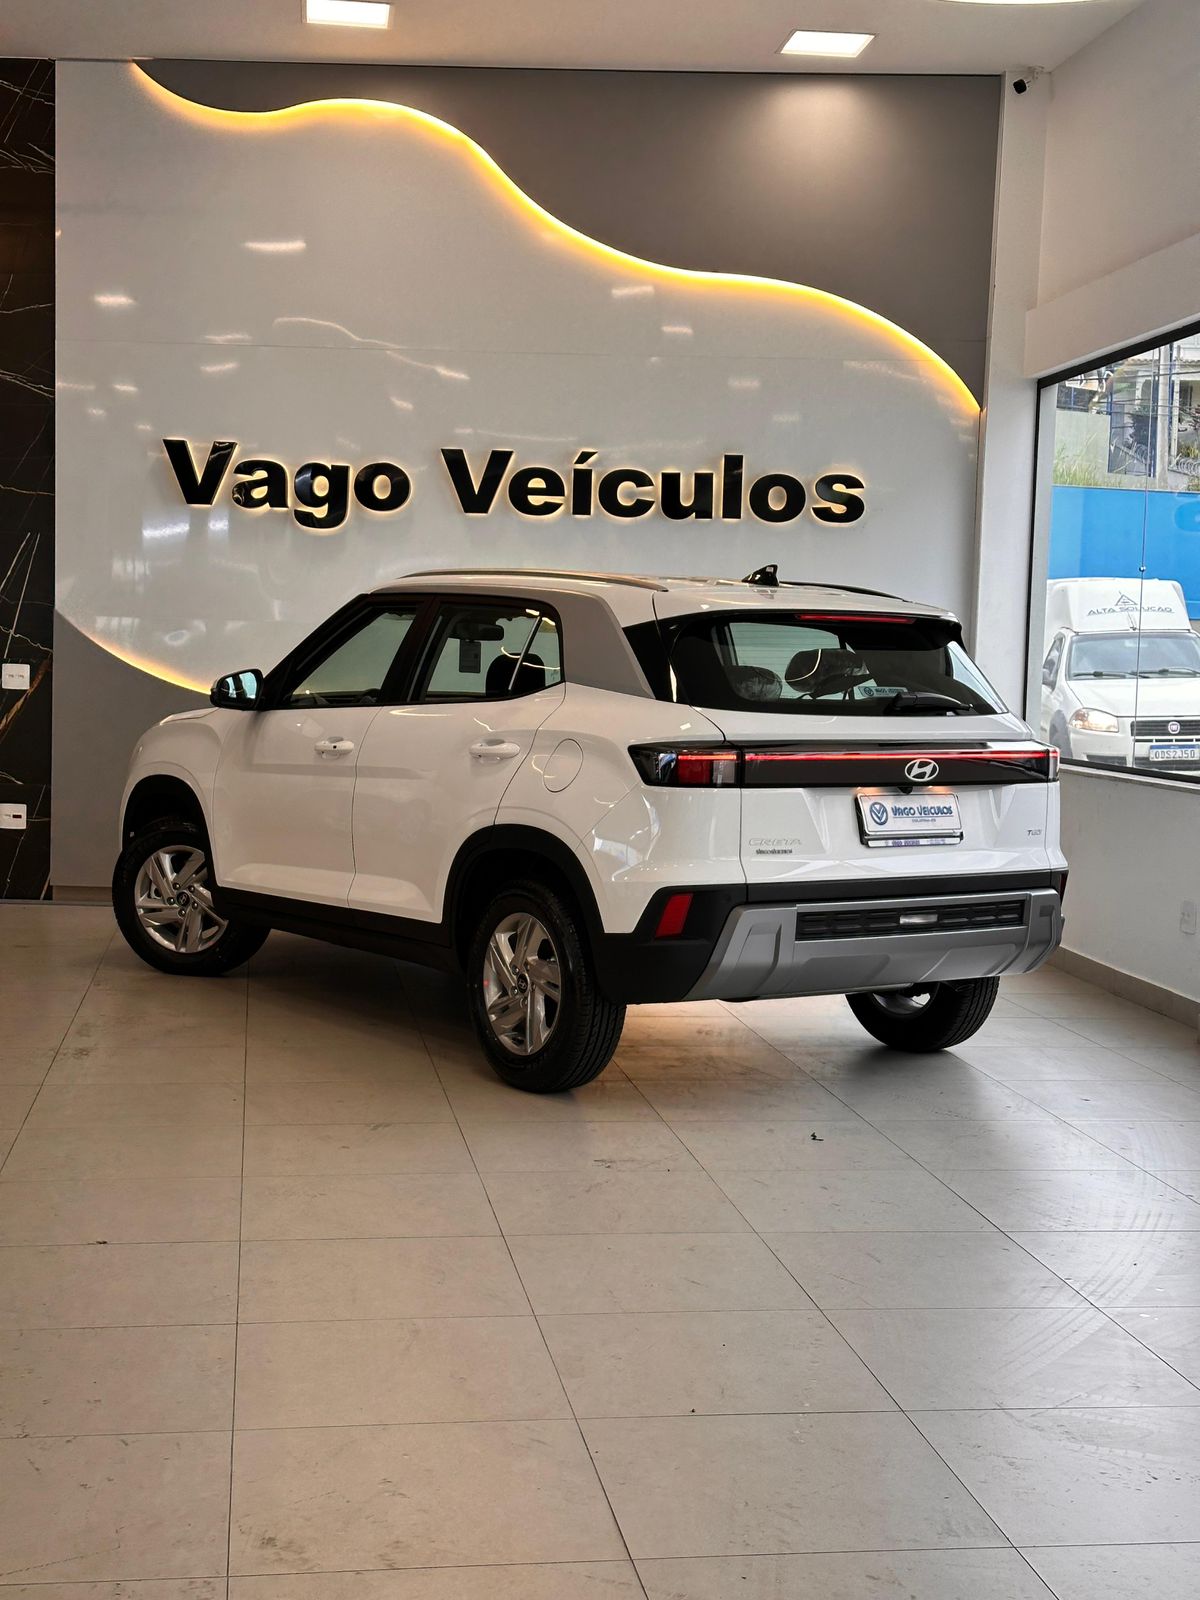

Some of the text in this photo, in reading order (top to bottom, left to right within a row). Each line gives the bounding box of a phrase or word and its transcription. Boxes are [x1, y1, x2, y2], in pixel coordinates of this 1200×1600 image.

[162, 438, 865, 529] Vago Veículos
[1087, 607, 1117, 616] ALTA
[891, 805, 915, 817] VAGO
